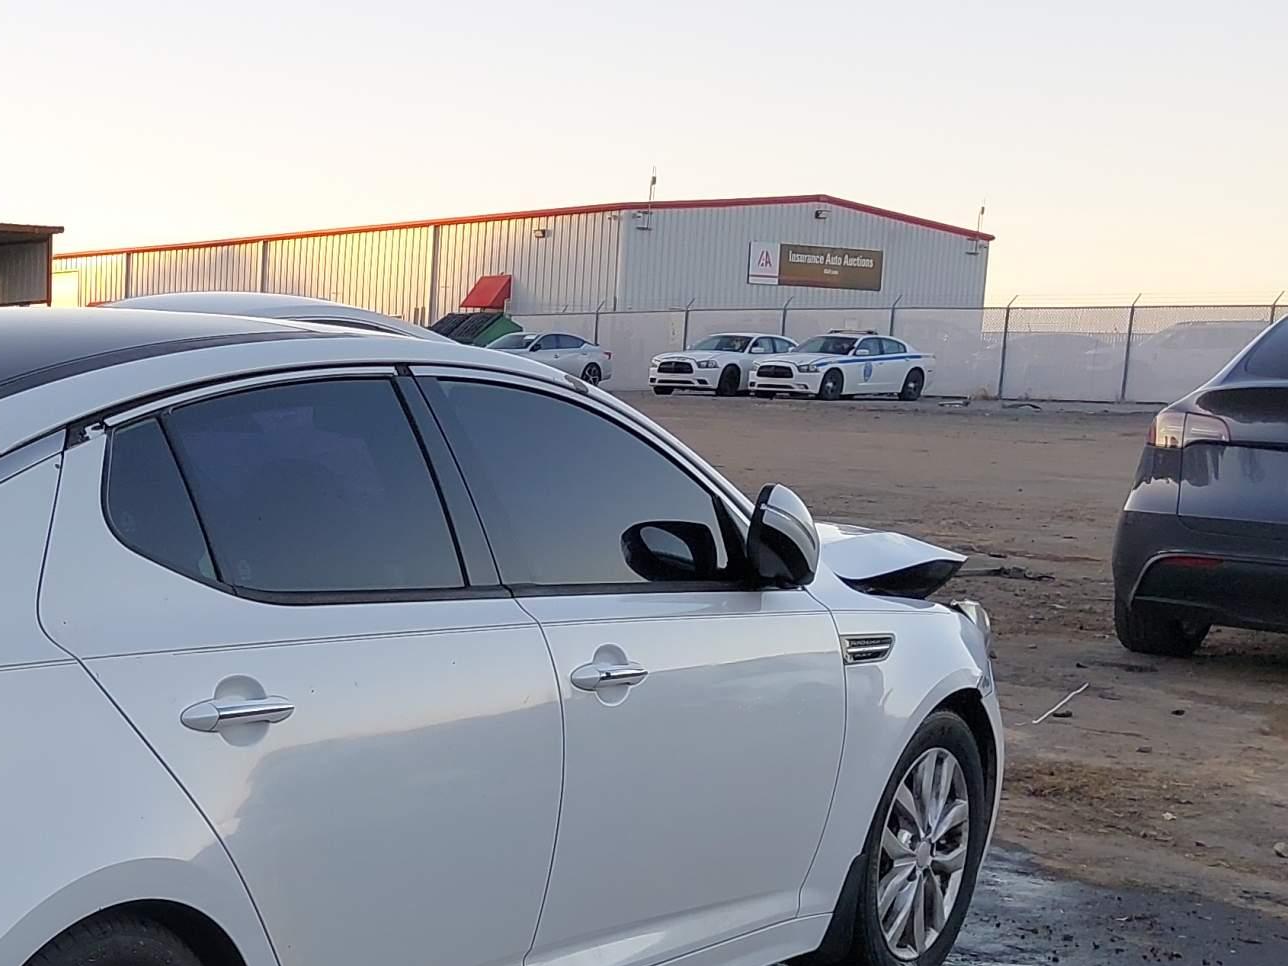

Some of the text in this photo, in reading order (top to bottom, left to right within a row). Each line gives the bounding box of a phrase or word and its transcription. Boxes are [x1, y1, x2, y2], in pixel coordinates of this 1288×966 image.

[788, 250, 874, 268] Insurance Auto Auctions
